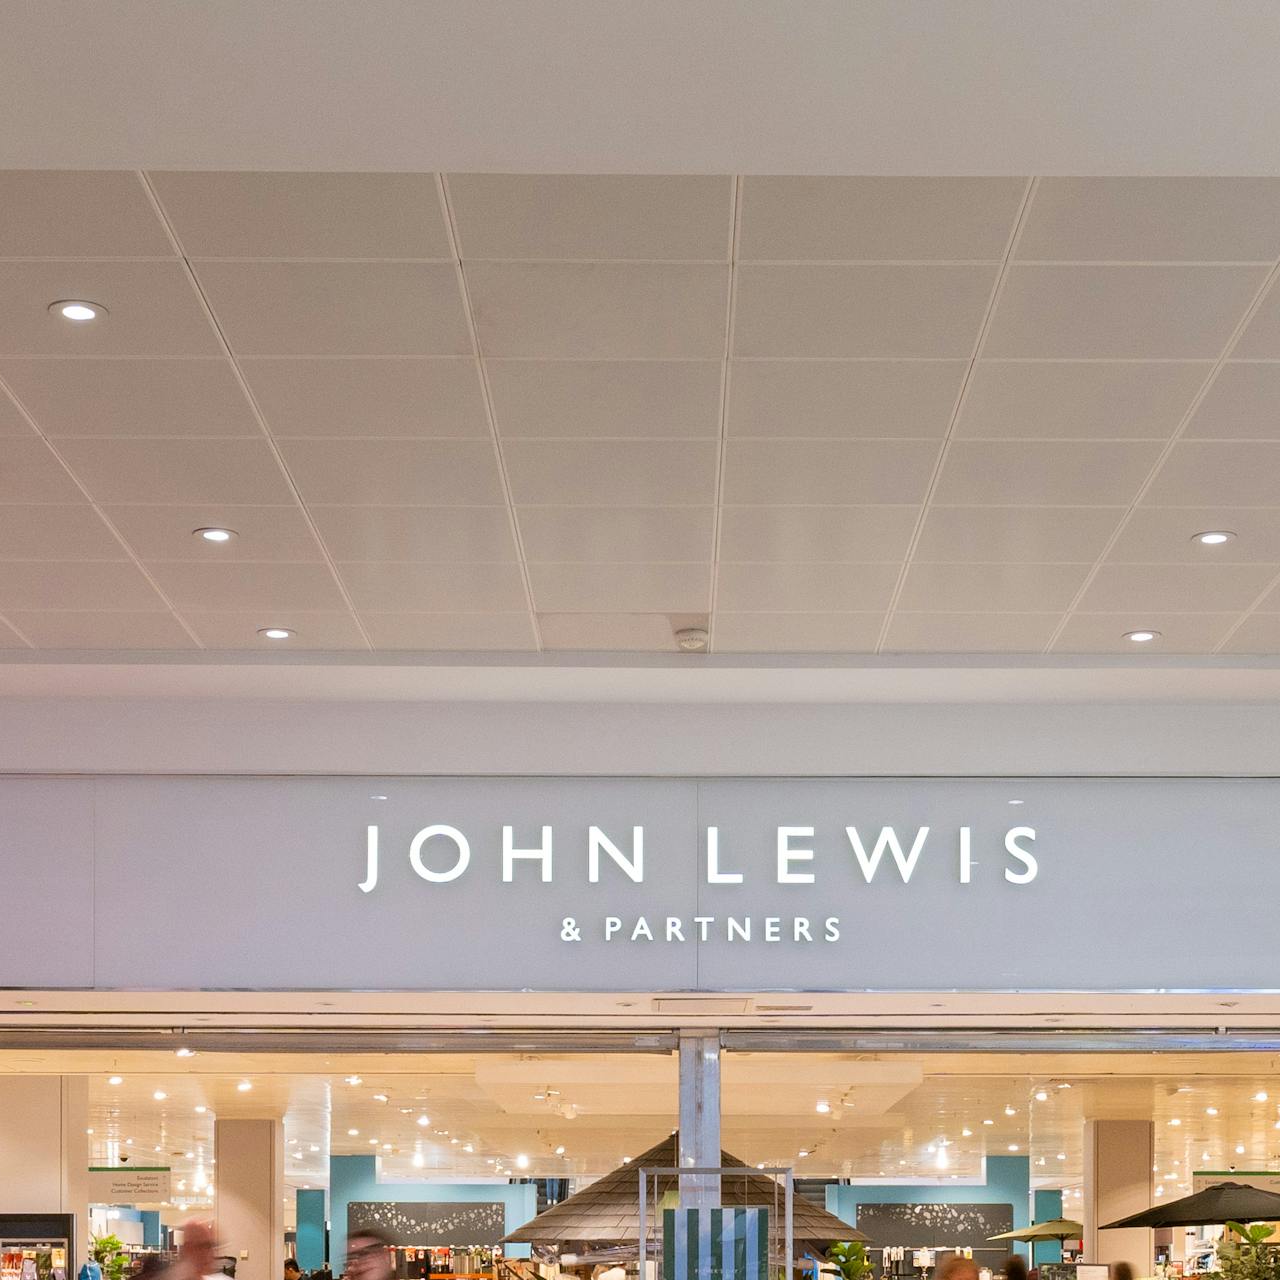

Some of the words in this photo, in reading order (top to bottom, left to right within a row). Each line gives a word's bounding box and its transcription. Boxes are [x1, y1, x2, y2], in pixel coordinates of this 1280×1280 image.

[357, 825, 644, 893] JOHN
[706, 825, 1038, 884] LEWIS
[560, 917, 582, 943] &
[605, 916, 842, 943] PARTNERS
